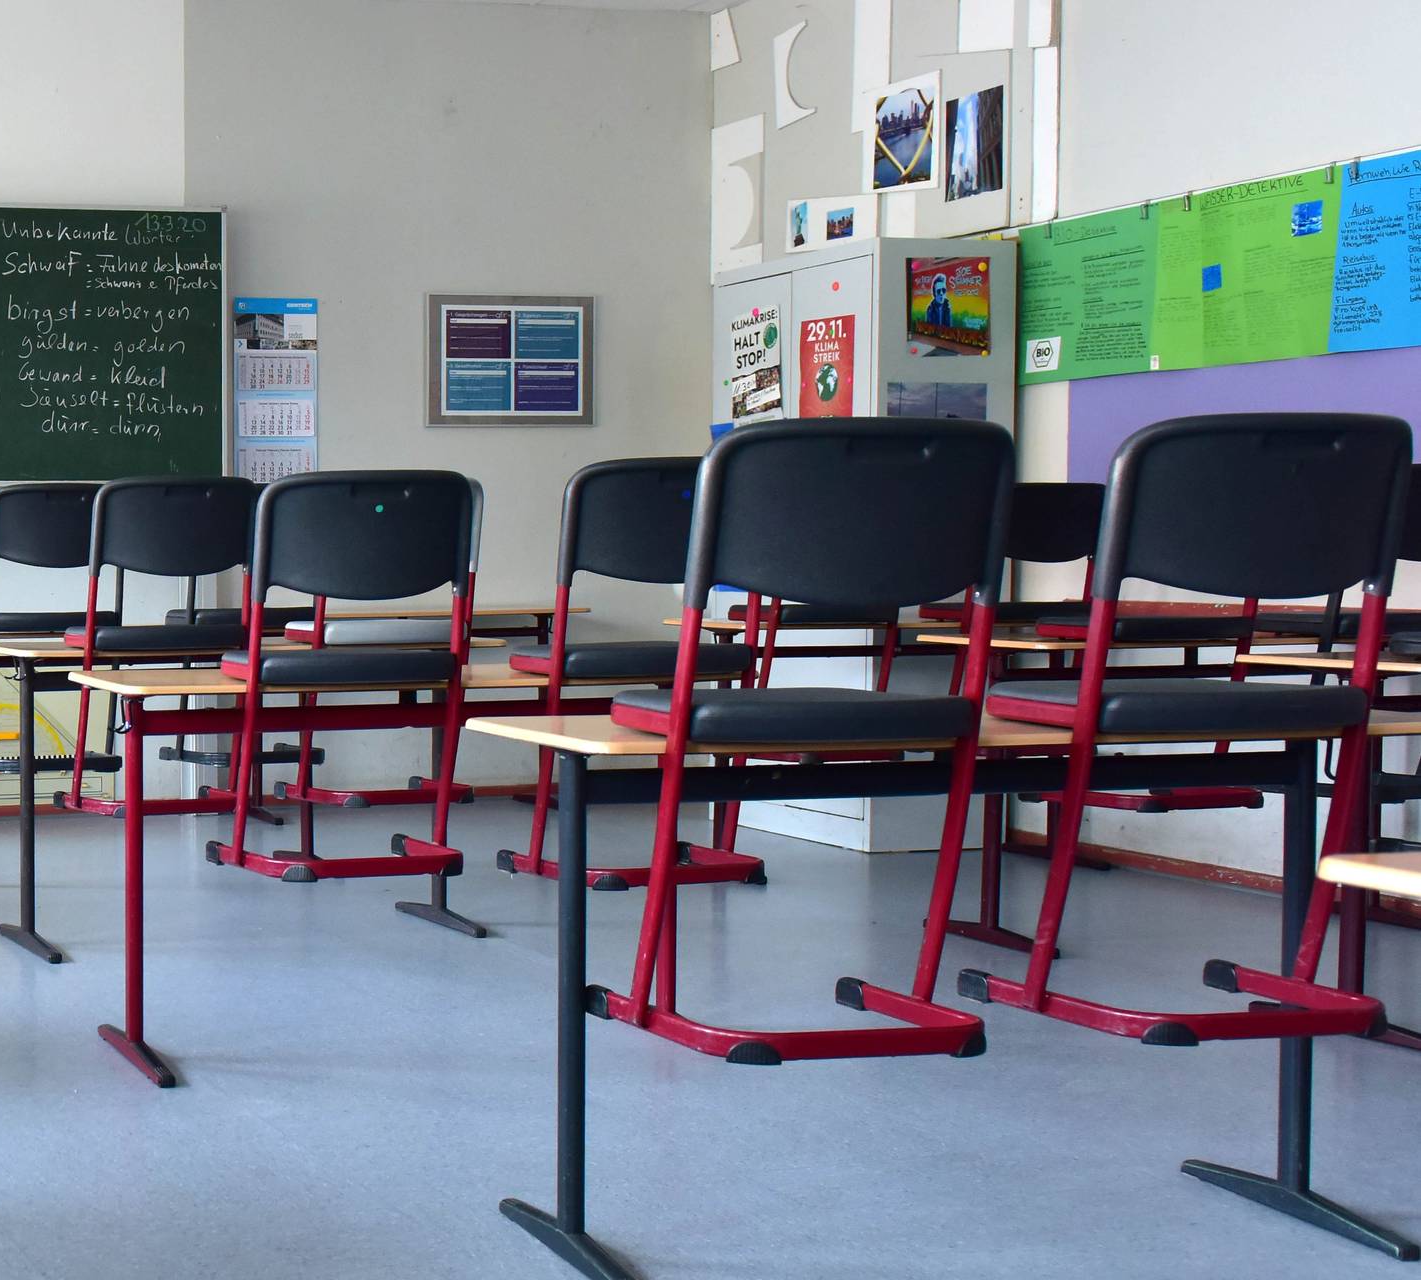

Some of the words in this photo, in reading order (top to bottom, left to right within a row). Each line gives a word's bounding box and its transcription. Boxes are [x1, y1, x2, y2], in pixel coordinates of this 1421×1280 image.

[731, 309, 778, 331] KLIMAKRISE:
[807, 319, 847, 342] 29.11.
[734, 331, 761, 351] HALT
[814, 341, 840, 352] KLIMA
[736, 349, 766, 369] STOP!
[813, 352, 840, 363] STREIK
